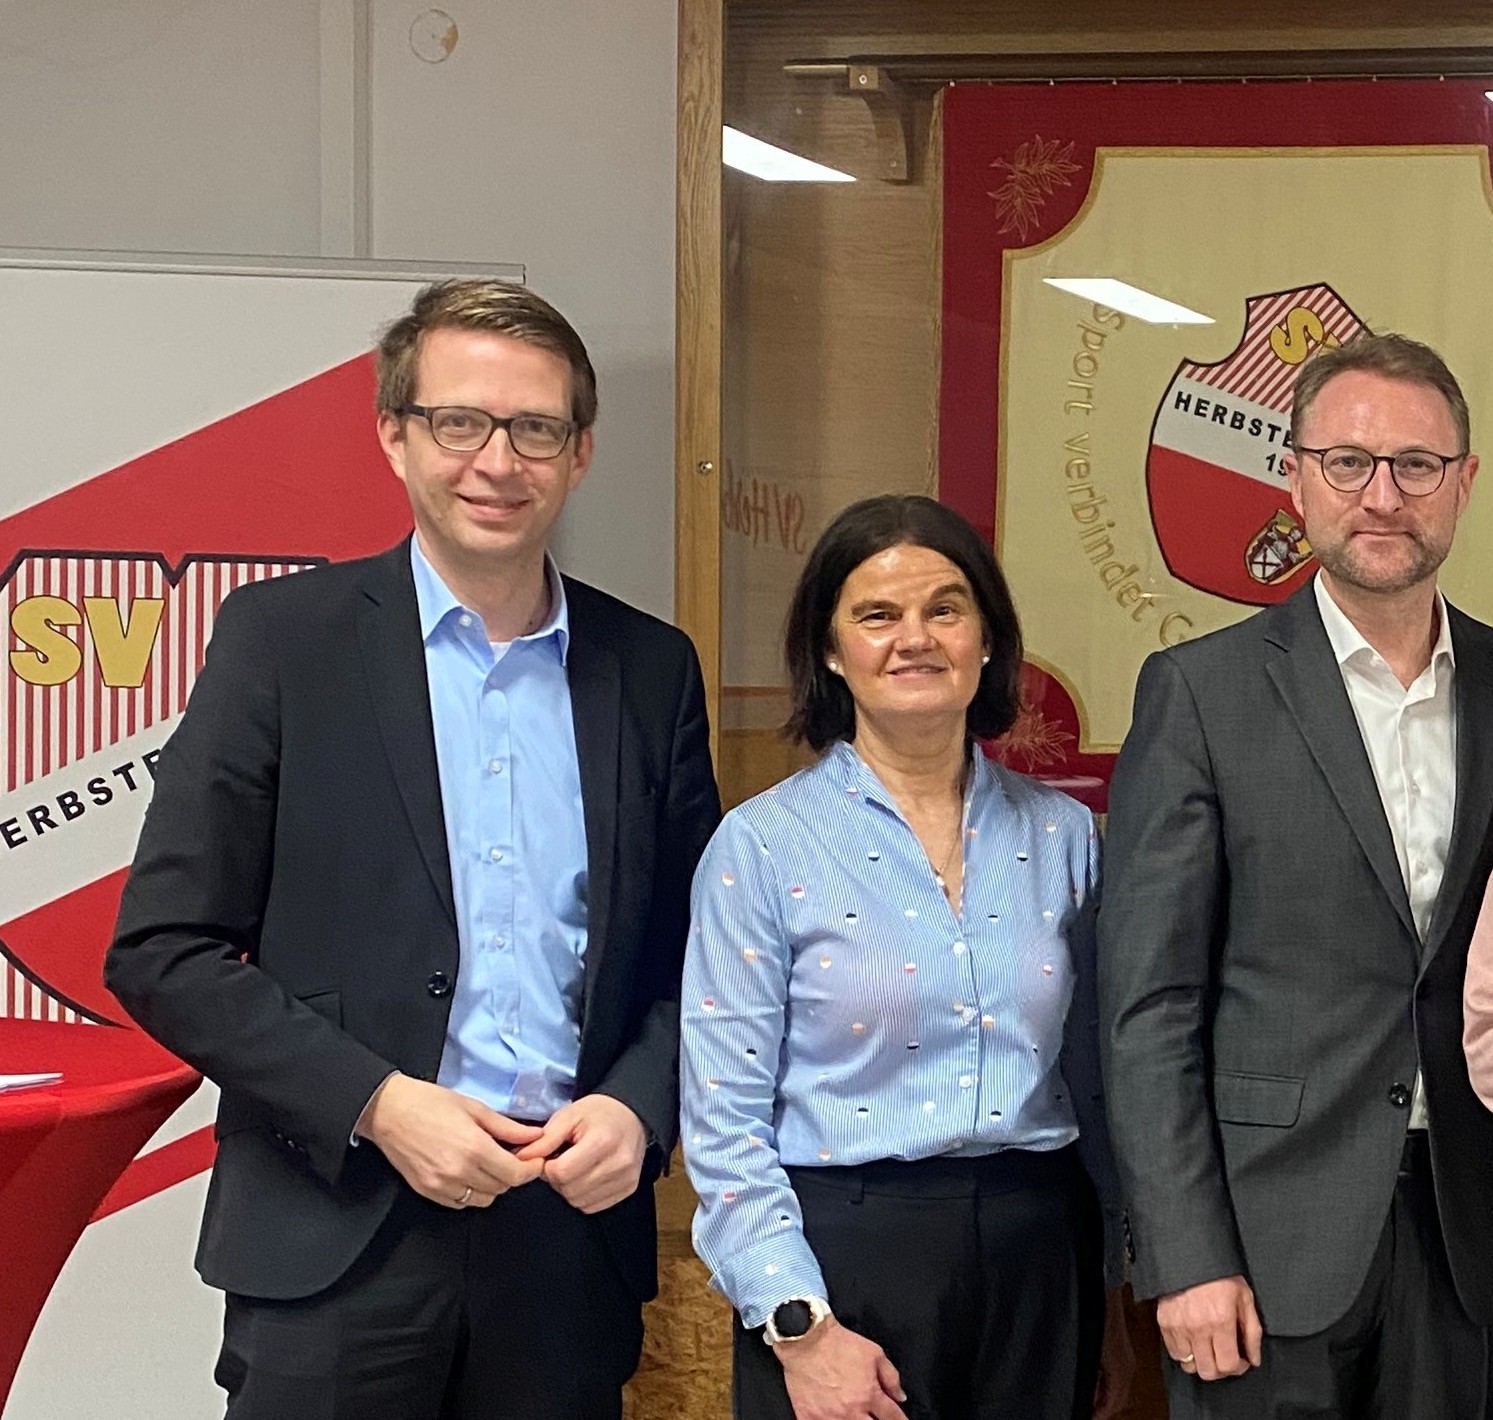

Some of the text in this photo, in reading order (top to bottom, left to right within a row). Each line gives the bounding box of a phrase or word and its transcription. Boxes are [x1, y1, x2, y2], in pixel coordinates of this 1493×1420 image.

[1064, 303, 1127, 416] Sport
[1269, 305, 1344, 366] S
[1063, 431, 1155, 623] verbindet
[9, 595, 166, 688] SV
